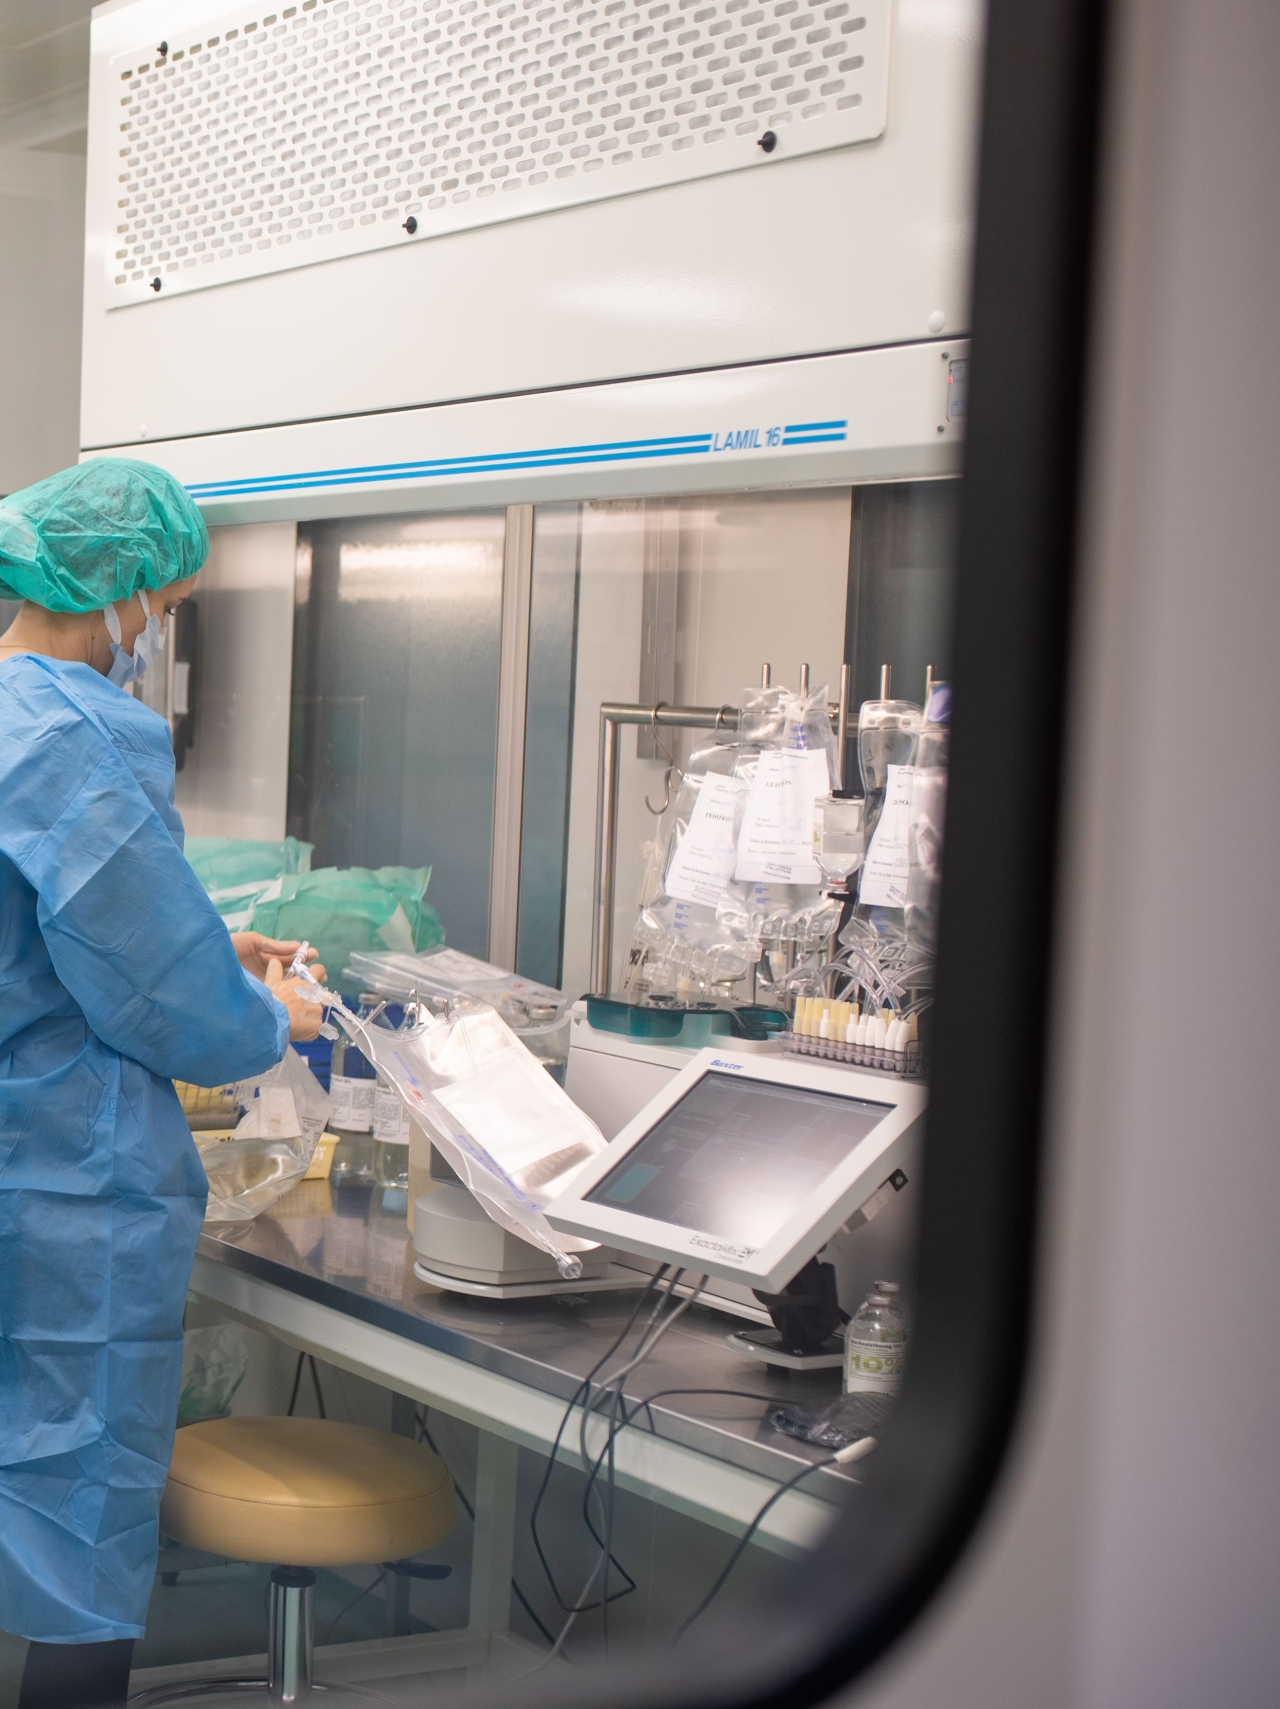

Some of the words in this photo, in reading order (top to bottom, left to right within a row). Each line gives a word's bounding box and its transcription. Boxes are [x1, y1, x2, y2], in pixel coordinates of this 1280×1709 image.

[713, 428, 762, 452] LAMIL
[766, 426, 782, 447] 16
[710, 1059, 744, 1070] Baxter
